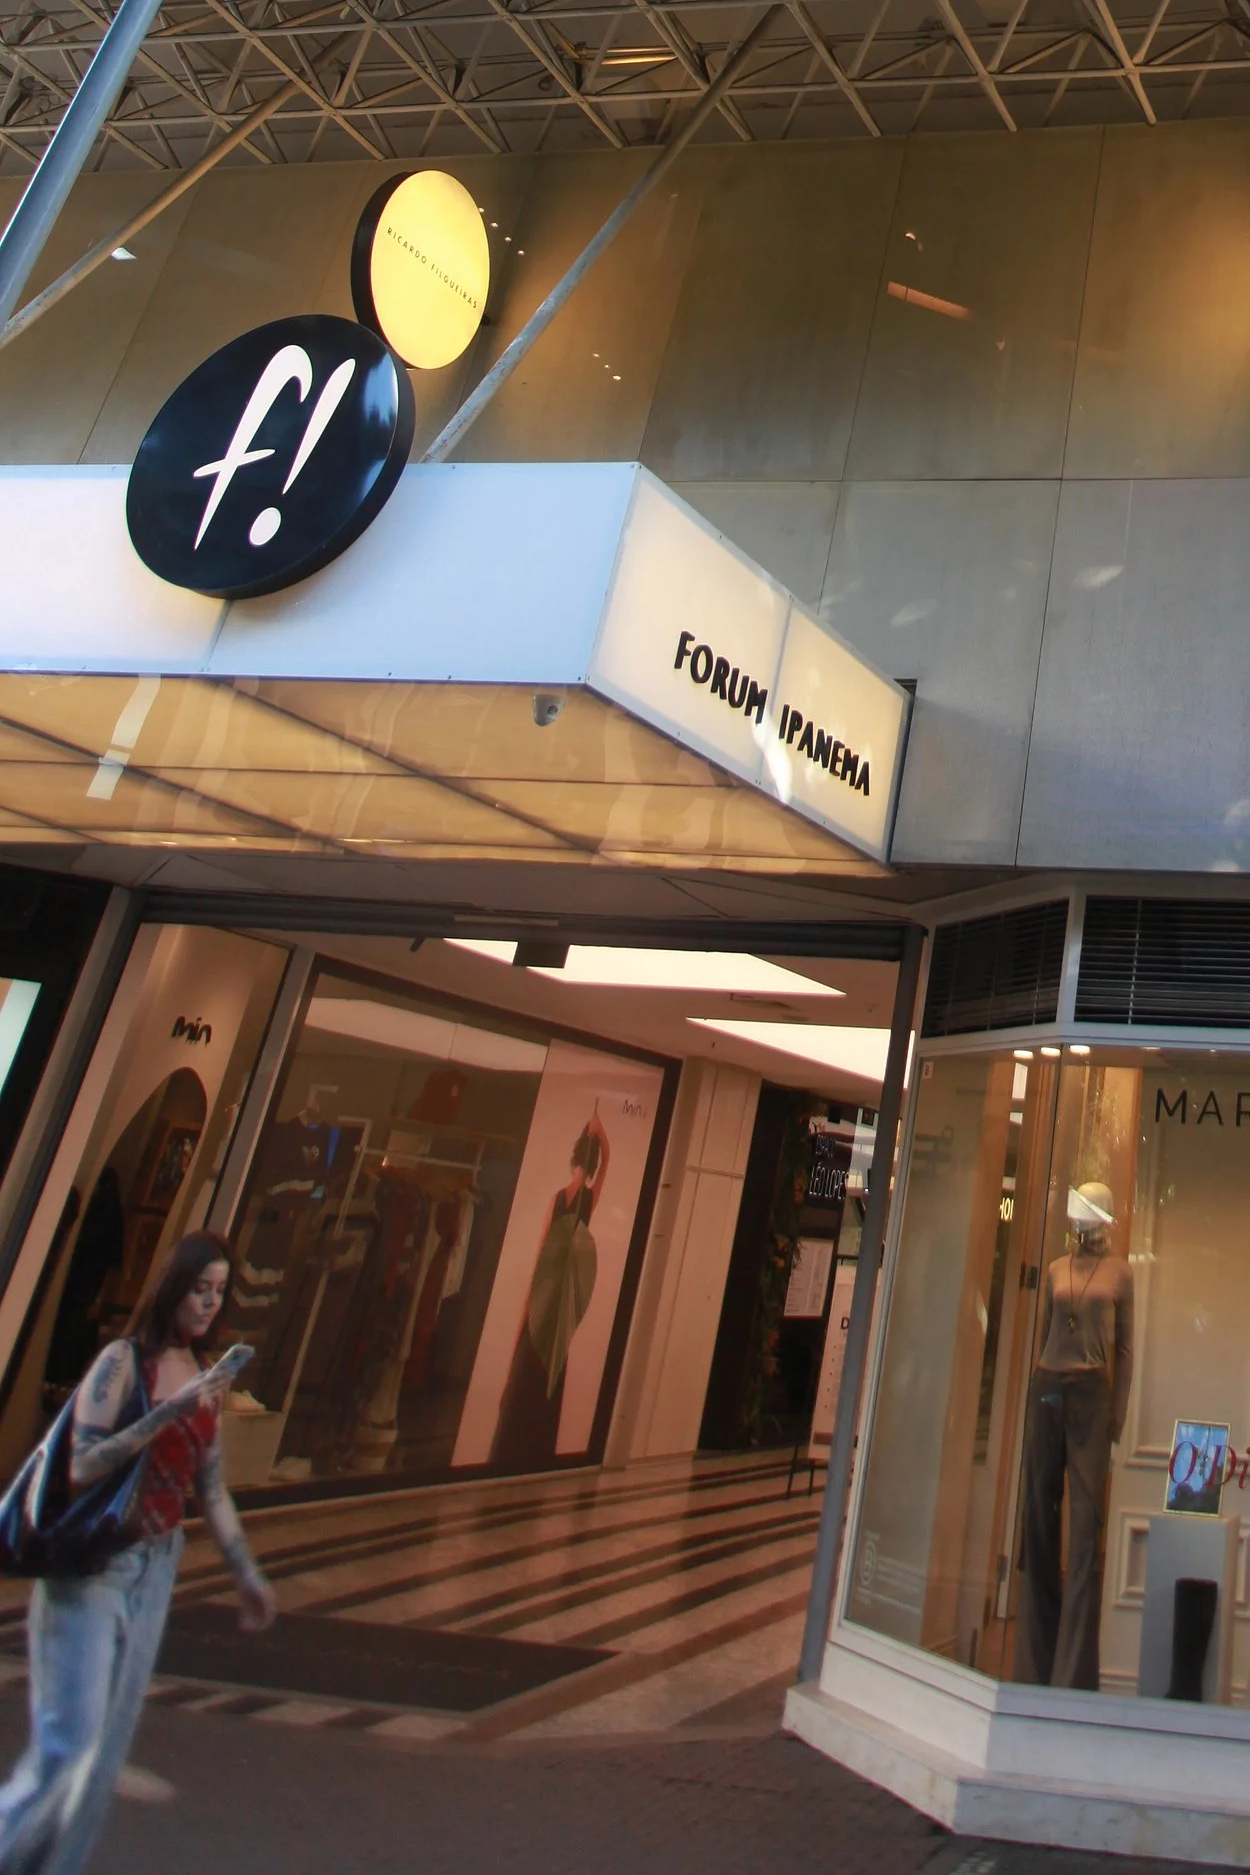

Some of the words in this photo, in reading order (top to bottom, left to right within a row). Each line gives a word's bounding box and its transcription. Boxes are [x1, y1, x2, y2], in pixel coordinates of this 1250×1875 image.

[386, 227, 427, 264] RICARDO
[430, 264, 478, 309] FILGUEIRAS
[674, 630, 768, 725] FORUM
[778, 704, 870, 796] IPANEMA
[1169, 1440, 1198, 1485] O
